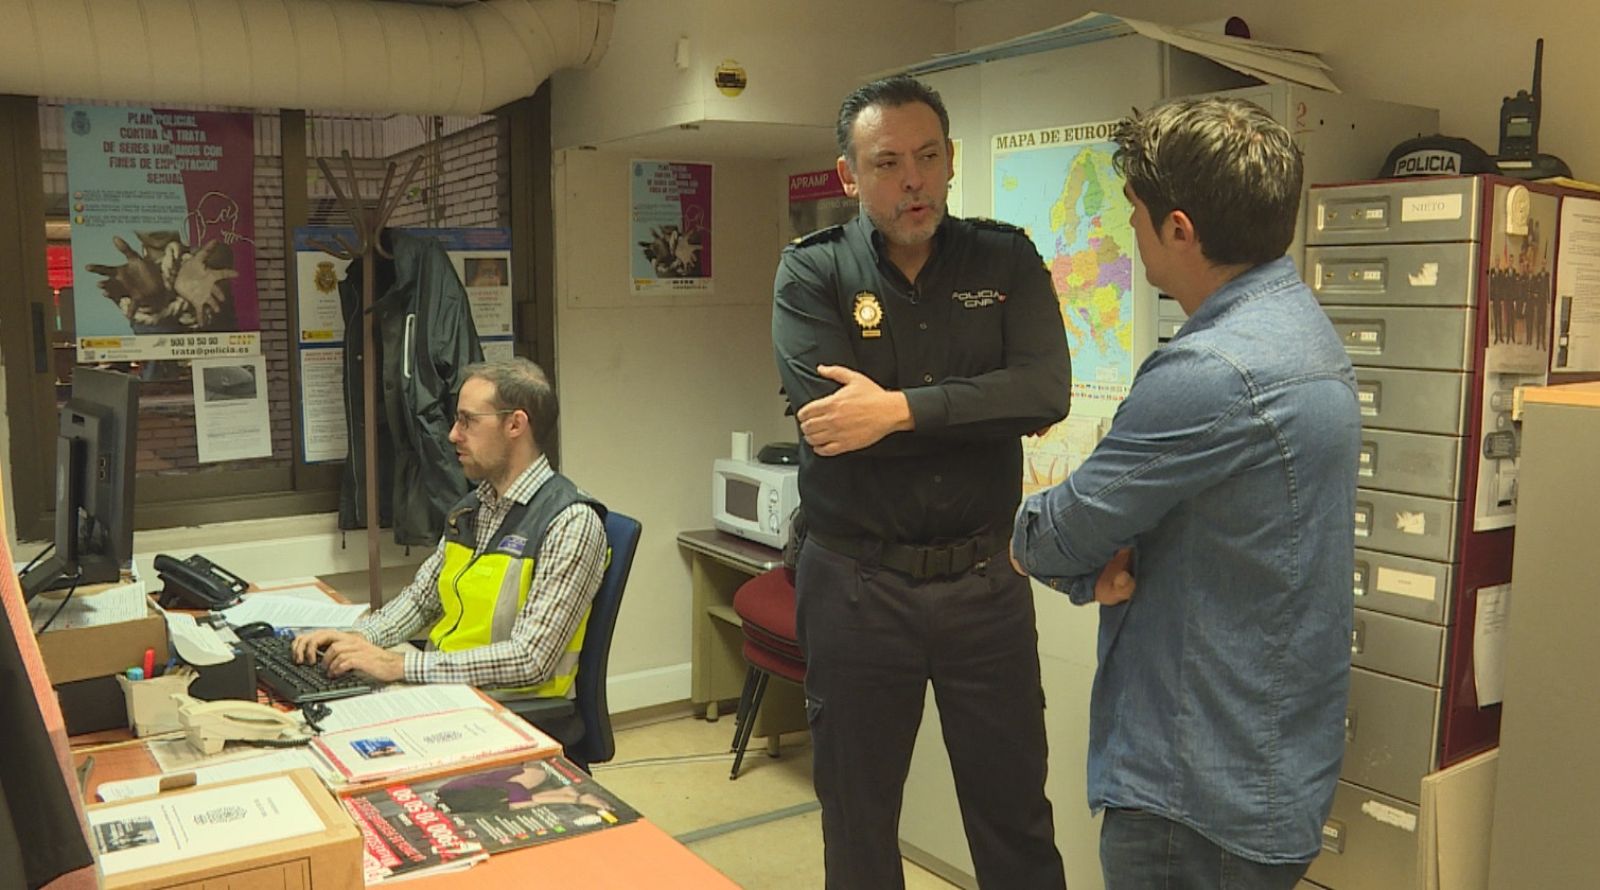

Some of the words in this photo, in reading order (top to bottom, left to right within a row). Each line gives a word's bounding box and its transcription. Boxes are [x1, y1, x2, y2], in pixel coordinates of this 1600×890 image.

[127, 112, 153, 126] PLAN
[120, 127, 158, 140] CONTRA
[176, 130, 207, 142] TRATA
[996, 132, 1036, 150] MAPA
[1040, 129, 1060, 144] DE
[1064, 122, 1119, 142] EUROP
[103, 141, 114, 153] DE
[120, 142, 149, 154] SERES
[109, 157, 137, 169] FINES
[140, 158, 152, 170] DE
[1396, 155, 1457, 175] POLICIA
[790, 173, 829, 190] APRAMP
[1412, 202, 1445, 212] NIETO
[171, 346, 249, 356] trata@policia.es
